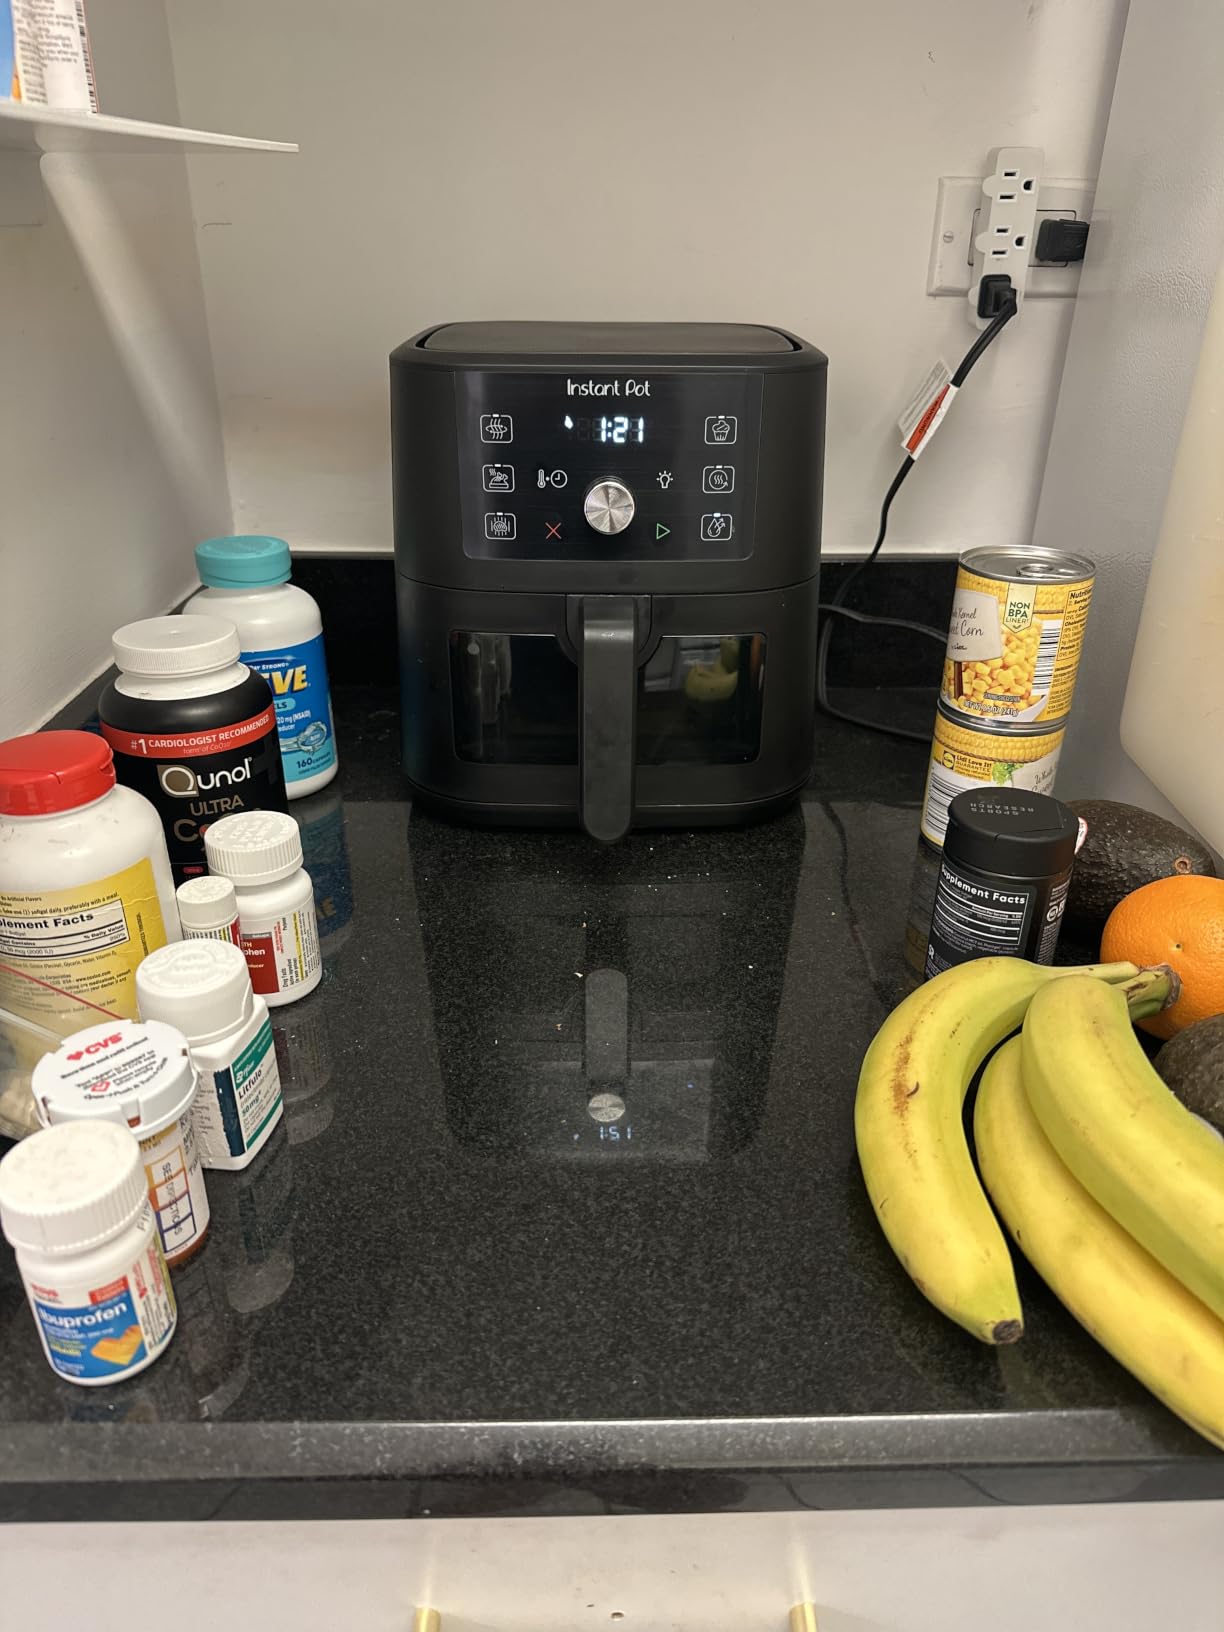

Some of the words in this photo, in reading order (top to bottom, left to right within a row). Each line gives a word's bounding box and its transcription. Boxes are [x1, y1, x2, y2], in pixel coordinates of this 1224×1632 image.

[567, 378, 620, 397] Instant
[625, 379, 651, 397] Pot
[600, 415, 644, 443] 1:21
[1008, 610, 1028, 619] BPA
[960, 619, 984, 637] Corn
[131, 738, 148, 755] #1
[149, 735, 217, 748] CARDIOLOGIST
[219, 714, 270, 741] RECOMMENDED
[296, 757, 313, 769] 160
[161, 757, 251, 796] Qunol
[190, 794, 245, 817] ULTRA
[970, 802, 1035, 813] RESEARCH
[970, 807, 1019, 816] SPORTS
[63, 902, 90, 912] preferably
[993, 892, 1026, 904] Facts
[0, 918, 49, 929] lement
[54, 913, 94, 927] Facts
[85, 1033, 122, 1054] CVS
[238, 1069, 262, 1099] Litfulo
